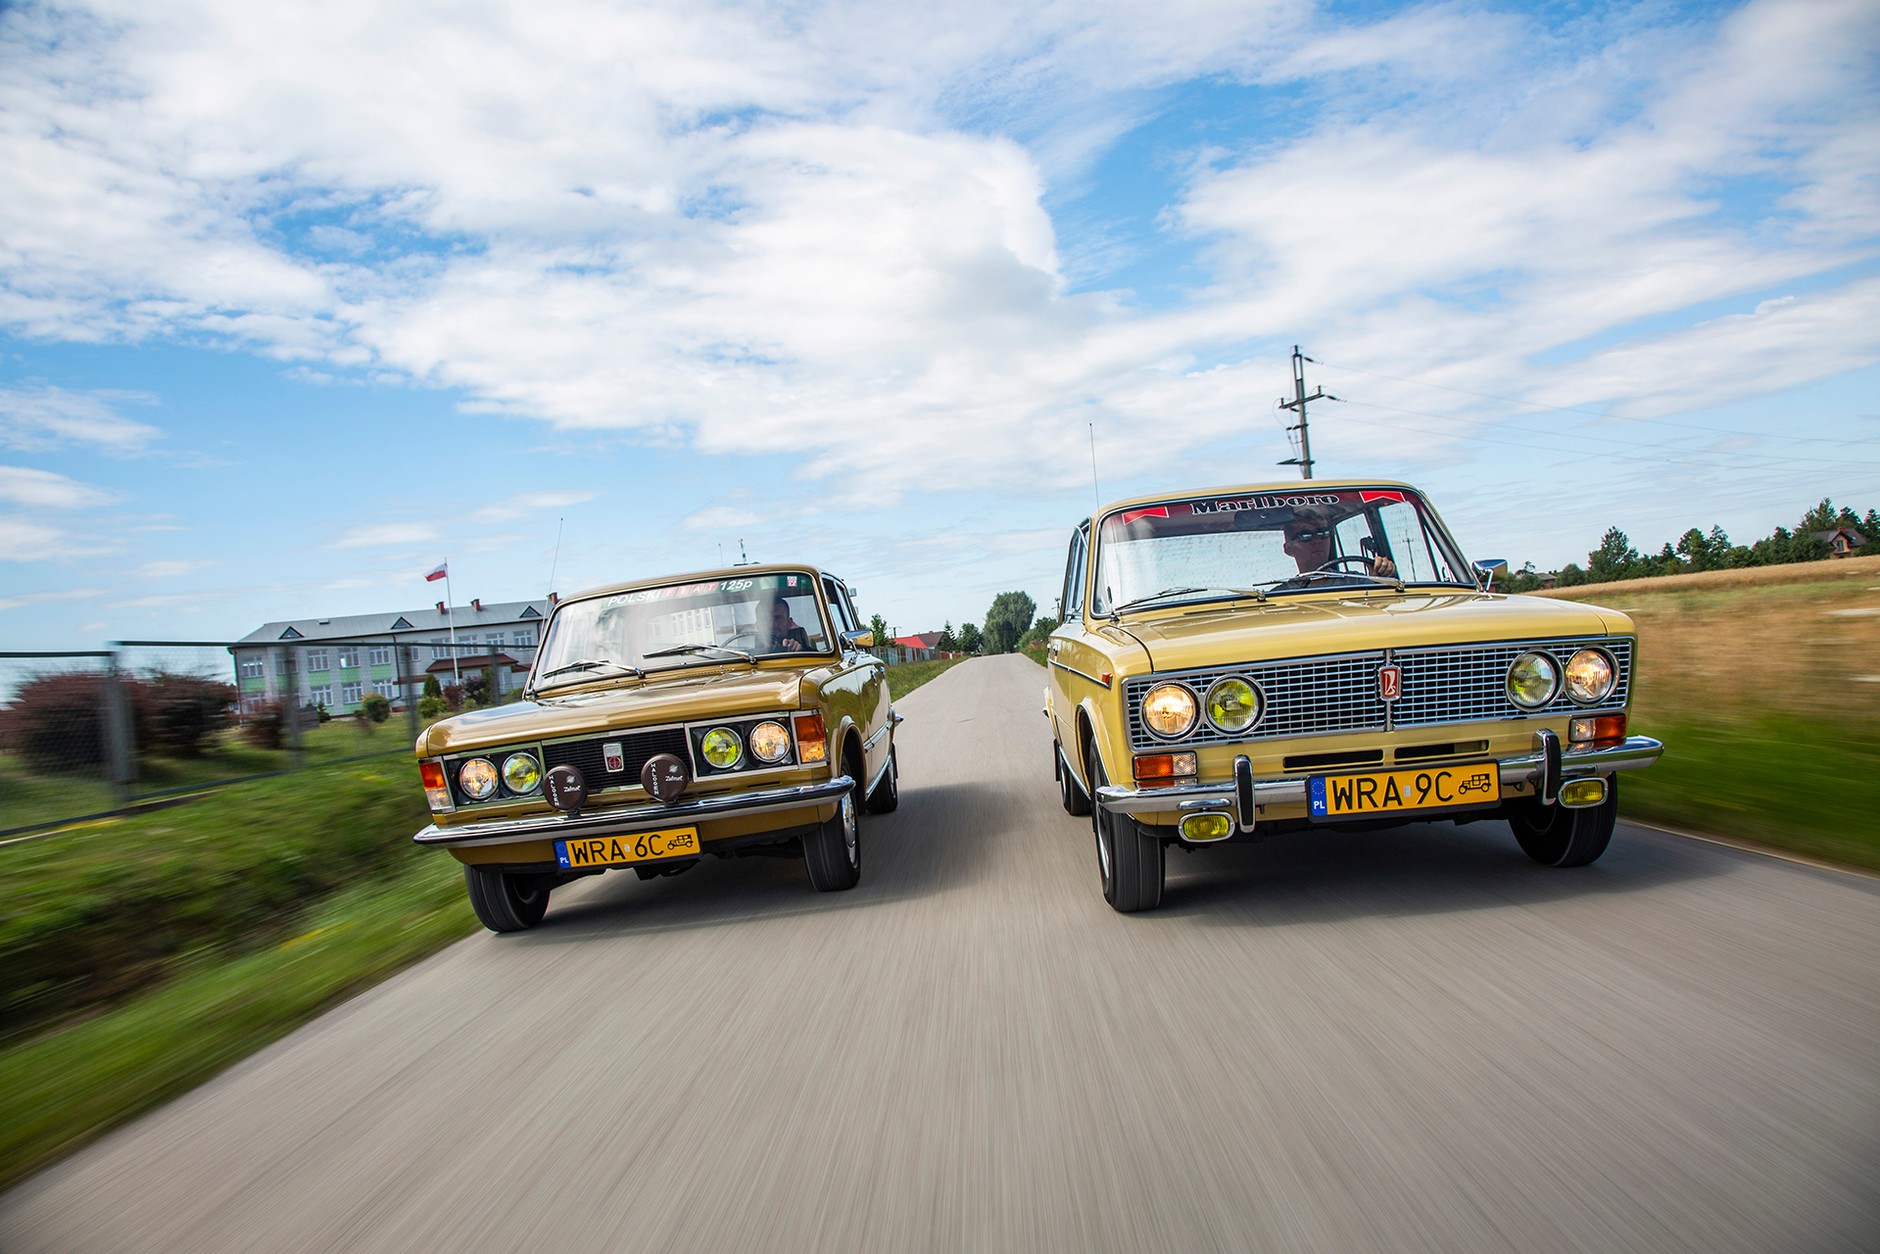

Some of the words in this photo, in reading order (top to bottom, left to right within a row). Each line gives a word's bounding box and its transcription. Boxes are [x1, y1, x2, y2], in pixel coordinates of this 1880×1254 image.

[1191, 494, 1340, 515] Marlboro
[607, 589, 662, 607] POLSKI
[664, 582, 717, 597] FIAT
[720, 579, 753, 591] 125p
[549, 774, 560, 807] HALOGEN
[651, 762, 660, 795] HALOGEN
[1332, 775, 1403, 811] WRA
[1415, 771, 1454, 805] 9C
[1313, 801, 1326, 810] PL
[570, 839, 626, 864] WRA
[634, 834, 664, 857] 6C
